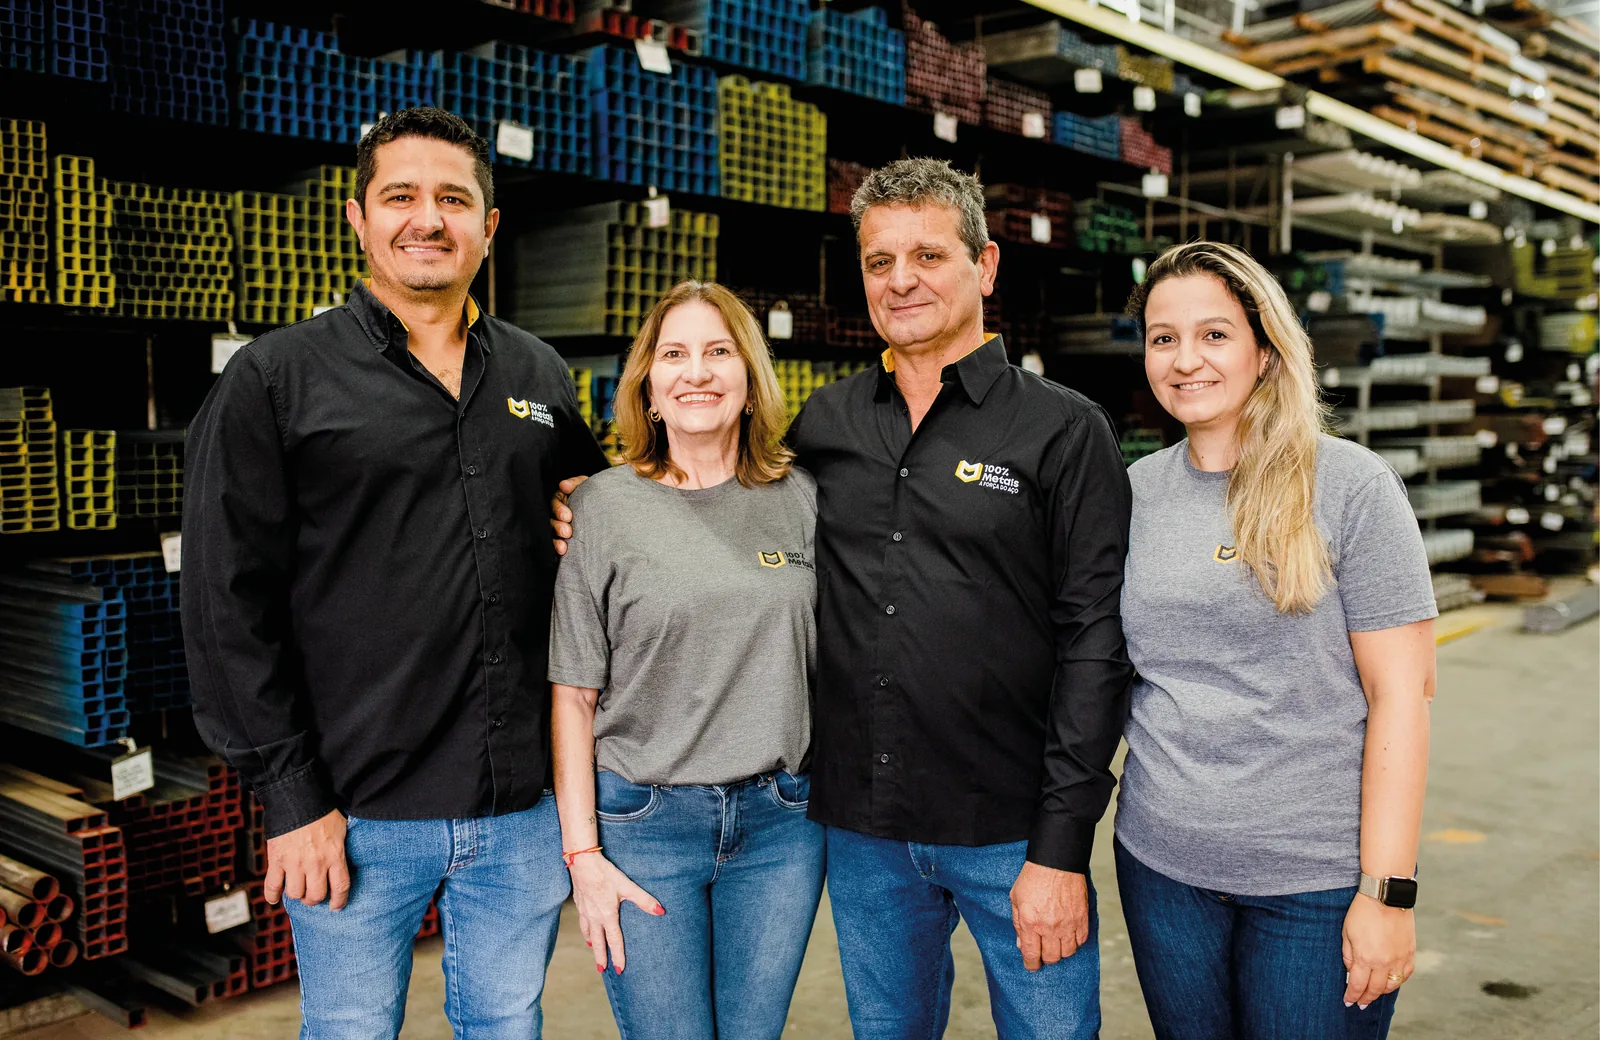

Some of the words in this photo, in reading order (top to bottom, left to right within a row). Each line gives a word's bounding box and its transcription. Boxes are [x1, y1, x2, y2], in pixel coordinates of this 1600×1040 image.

[529, 401, 548, 412] 100%
[984, 464, 1009, 477] 100%
[981, 472, 1020, 488] Metais
[982, 481, 1000, 490] FORÇA
[1007, 486, 1019, 494] AÇO
